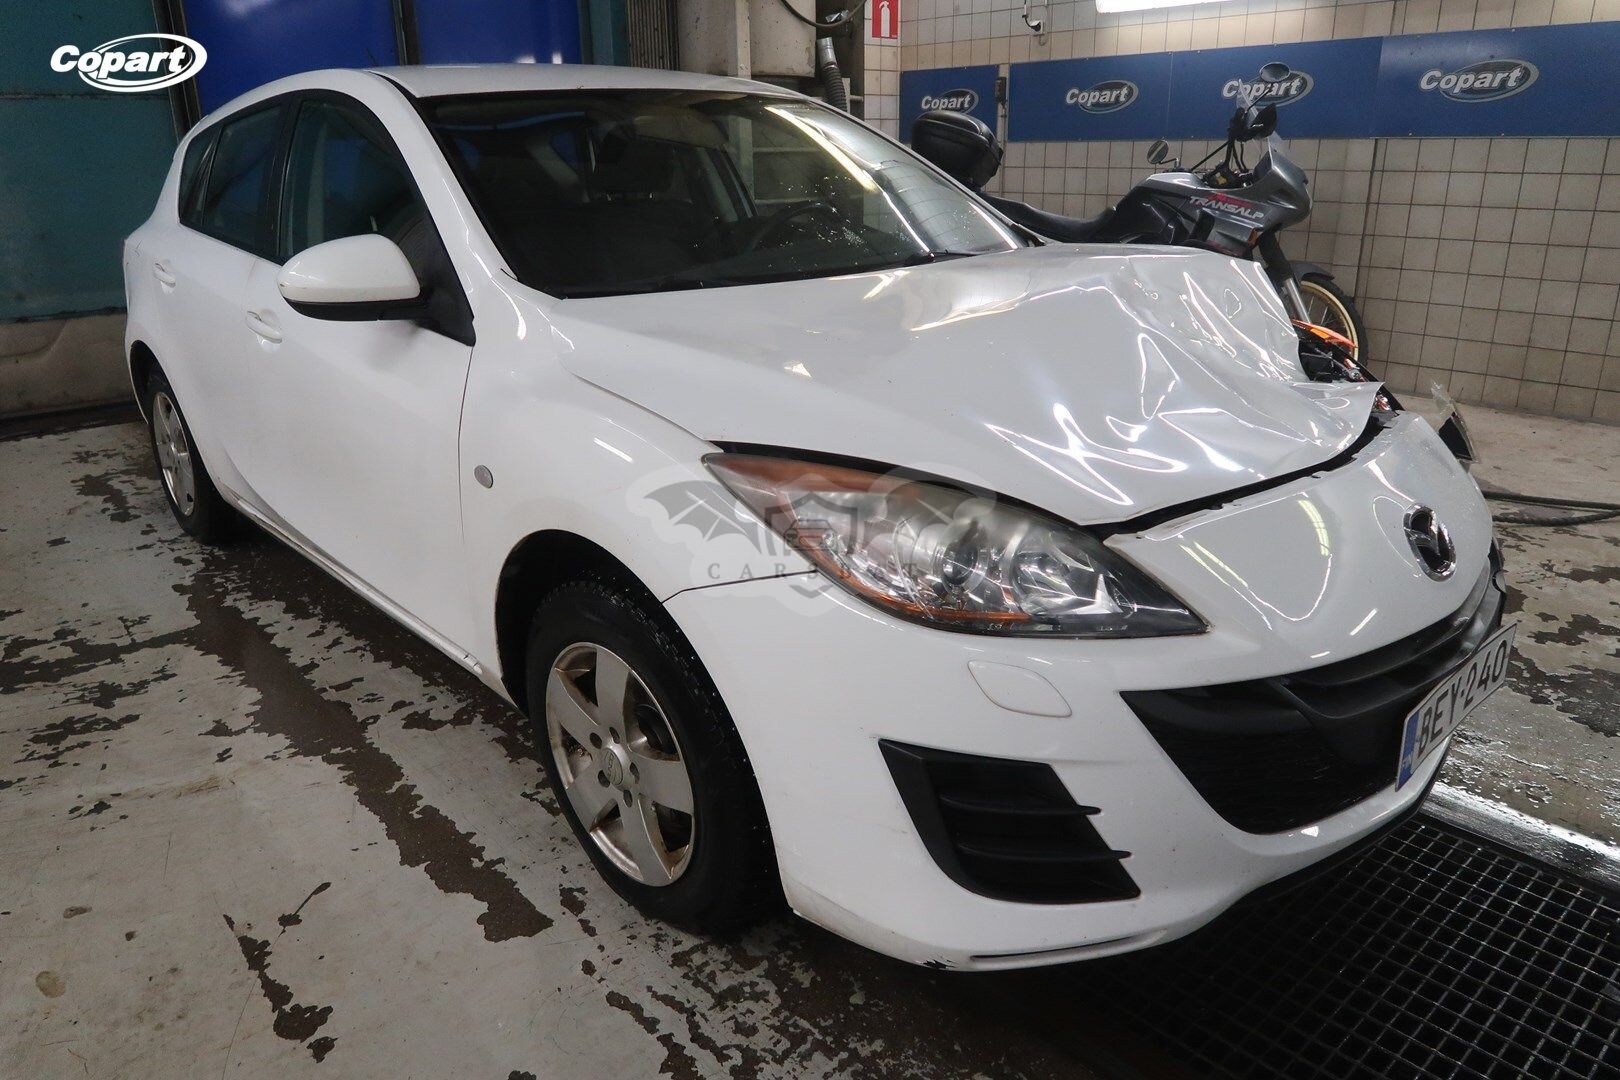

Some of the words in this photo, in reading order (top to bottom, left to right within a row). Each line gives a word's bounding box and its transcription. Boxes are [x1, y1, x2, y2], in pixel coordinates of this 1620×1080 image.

[1420, 65, 1524, 94] Copart
[921, 94, 971, 111] Copart
[1066, 86, 1128, 107] Copart
[1189, 196, 1265, 219] TRANSALP
[1417, 639, 1508, 759] BEY-240
